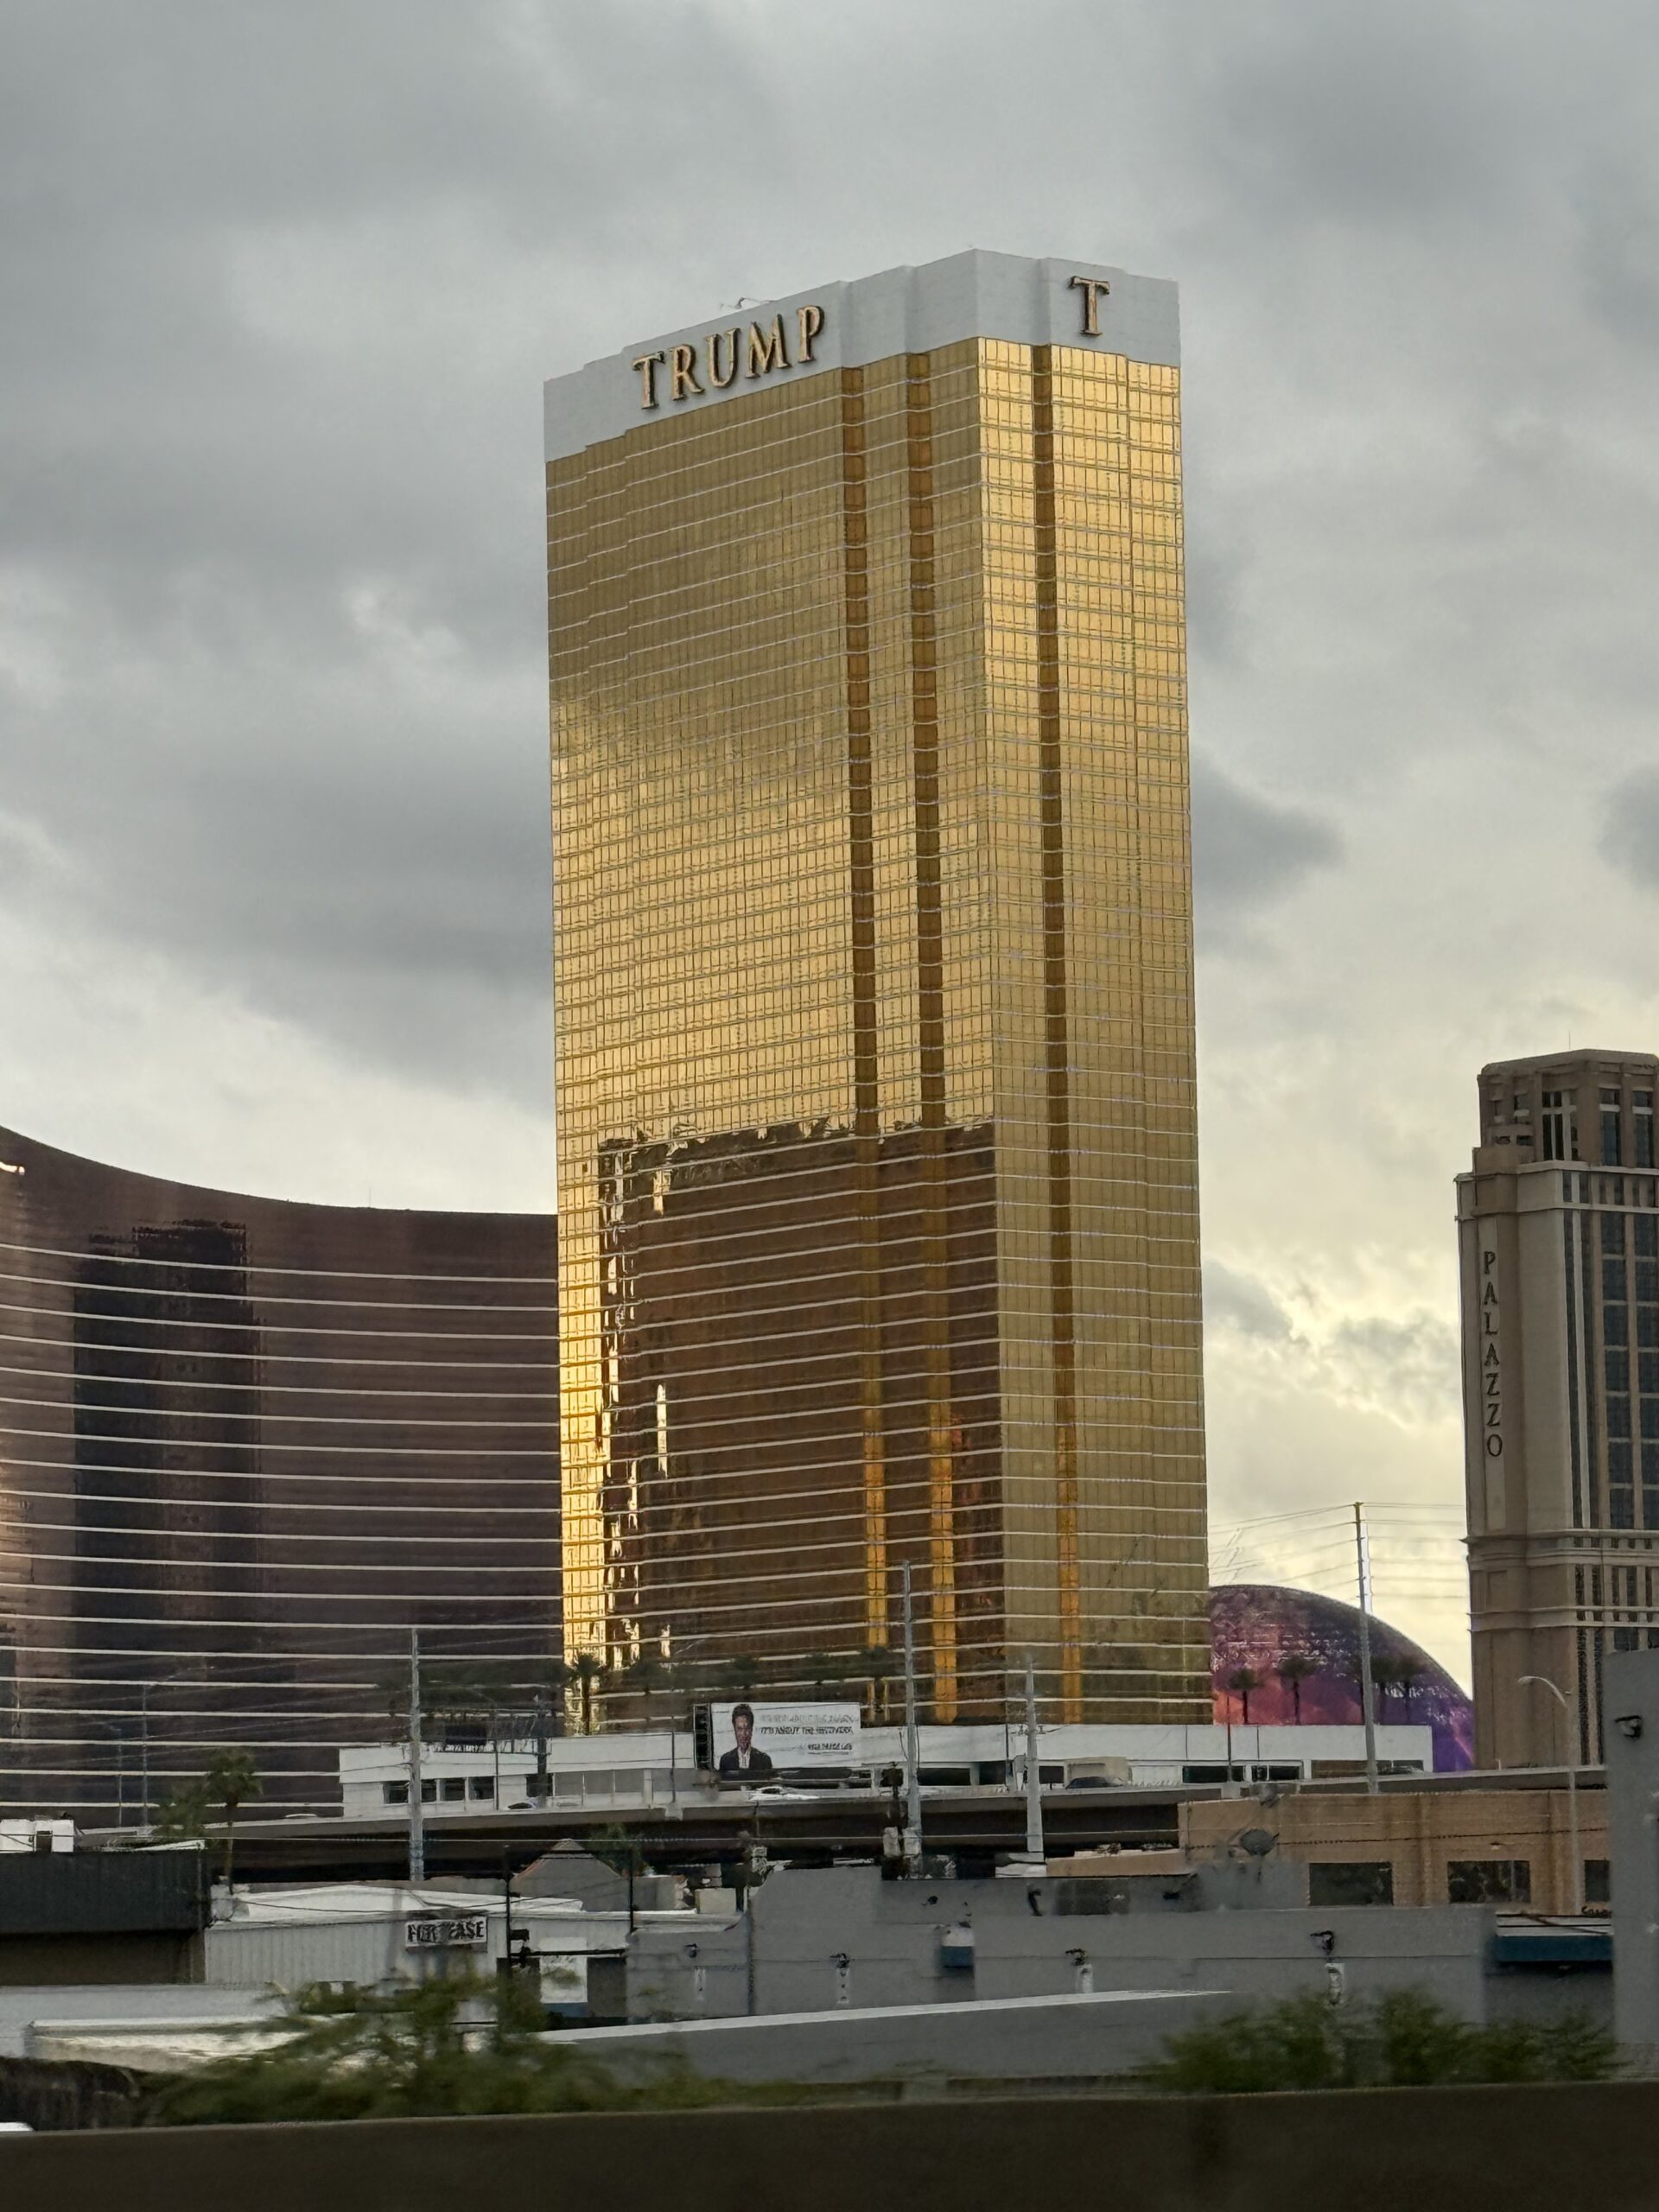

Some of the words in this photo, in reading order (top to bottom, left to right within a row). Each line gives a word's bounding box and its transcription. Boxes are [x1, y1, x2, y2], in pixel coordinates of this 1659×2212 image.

[1069, 276, 1110, 335] T
[632, 306, 824, 410] TRUMP
[1484, 1251, 1503, 1457] PALAZZO
